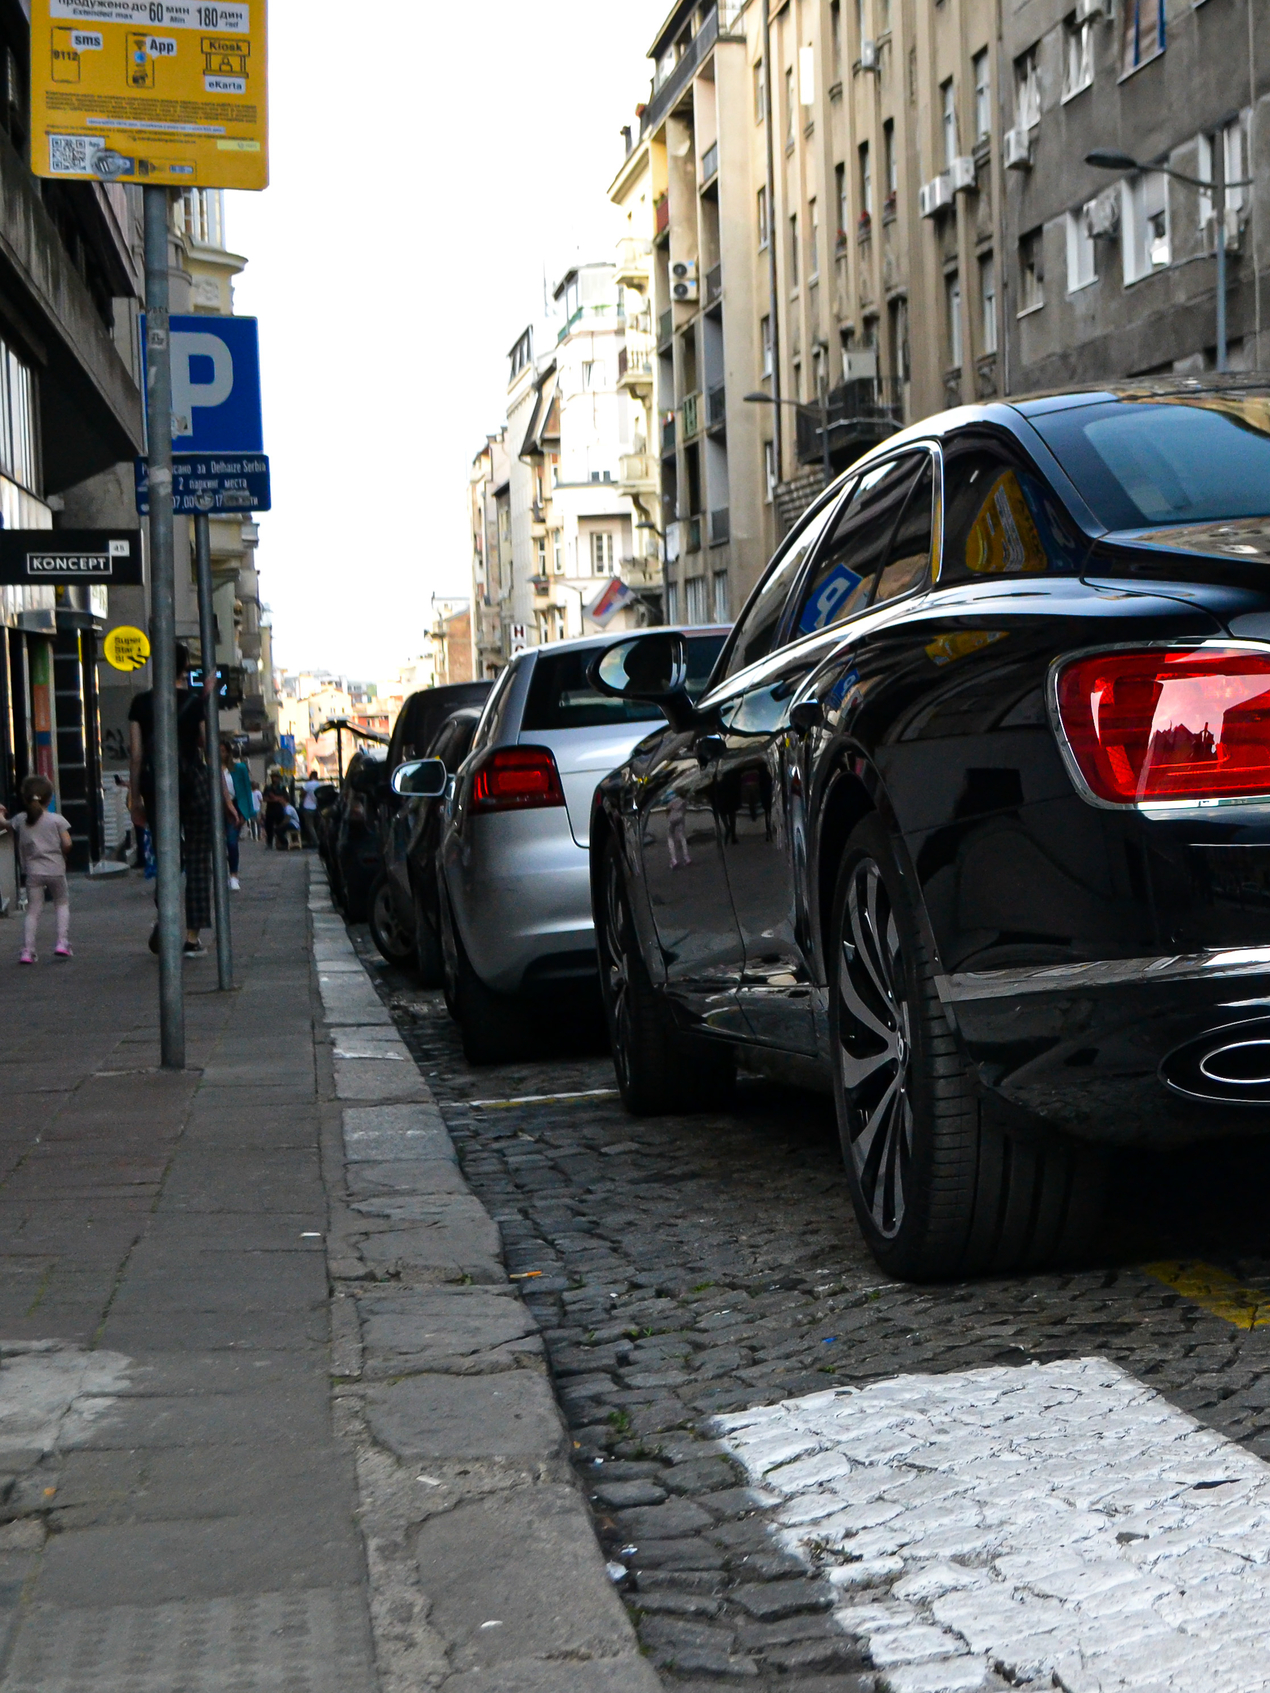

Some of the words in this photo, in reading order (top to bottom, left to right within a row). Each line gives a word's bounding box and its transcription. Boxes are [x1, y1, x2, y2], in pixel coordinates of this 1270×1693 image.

[131, 2, 147, 12] до
[149, 2, 163, 22] 60
[197, 7, 218, 27] 180
[75, 35, 101, 46] sms
[150, 38, 174, 55] App
[209, 41, 242, 52] Kiosk
[208, 80, 242, 90] eKarta
[170, 331, 233, 436] P
[179, 476, 184, 490] 2
[224, 478, 247, 488] места
[33, 557, 106, 570] KONCEPT
